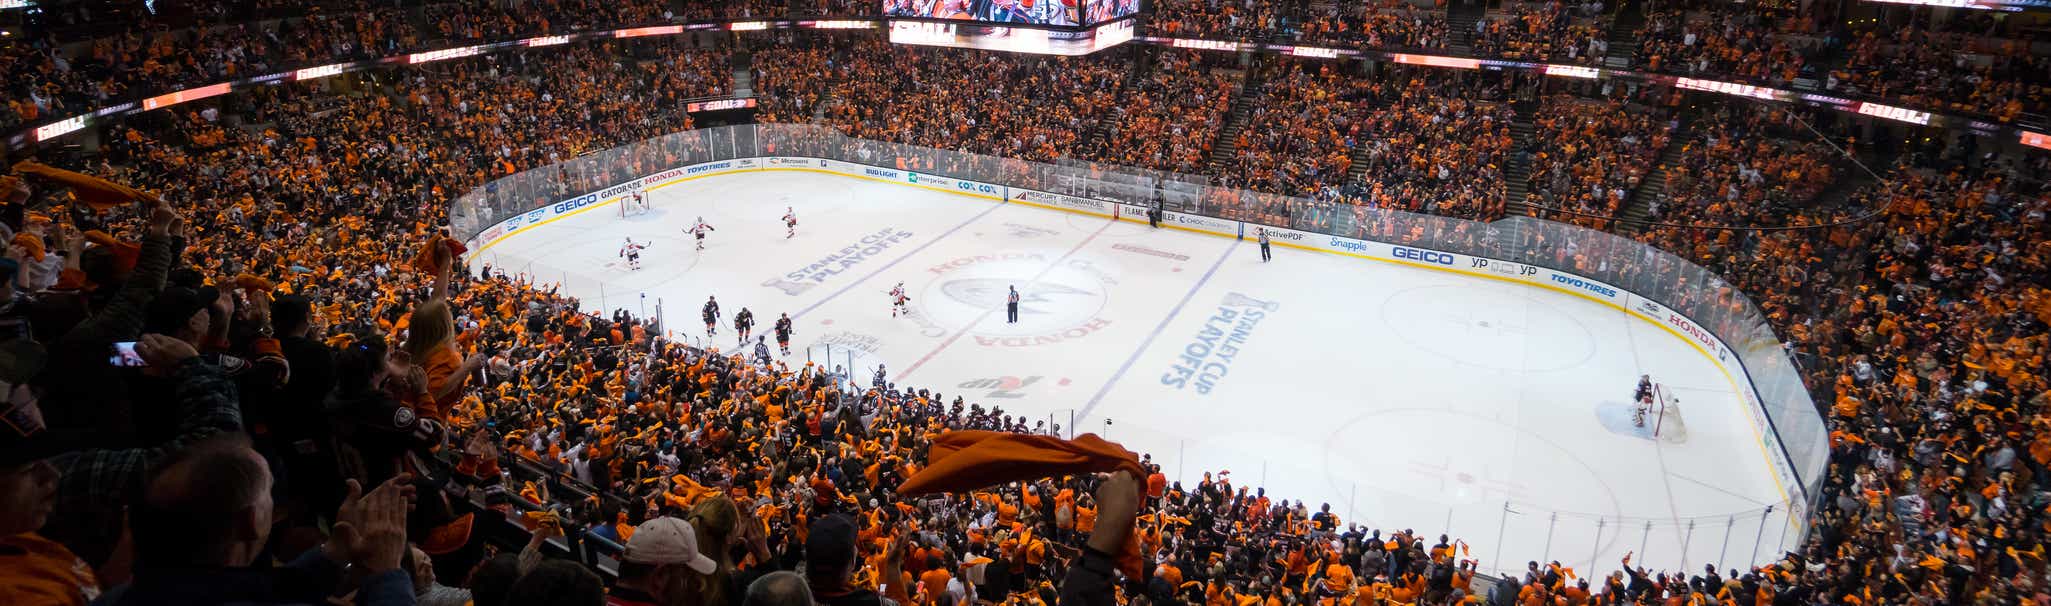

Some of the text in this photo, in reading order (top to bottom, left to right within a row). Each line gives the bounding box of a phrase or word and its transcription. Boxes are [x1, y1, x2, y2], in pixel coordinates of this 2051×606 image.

[644, 169, 683, 185] HONDA
[687, 163, 708, 174] TOYO
[709, 161, 731, 170] TIRES
[865, 168, 898, 179] BUD LIGHT
[958, 181, 998, 194] COX COX
[554, 194, 597, 214] GEICO
[1125, 206, 1145, 217] FLAME
[1186, 217, 1205, 227] CHOC
[786, 226, 894, 282] STANLEY CUP
[1330, 237, 1367, 252] Snapple
[808, 230, 914, 283] PLAYOFFS
[1392, 246, 1454, 265] GEICO
[1471, 256, 1537, 277] yp yp
[1551, 273, 1617, 298] TOYO TIRES
[1668, 313, 1718, 352] HONDA
[1161, 306, 1239, 391] PLAYOFFS
[1193, 307, 1266, 396] STANLEY CUP
